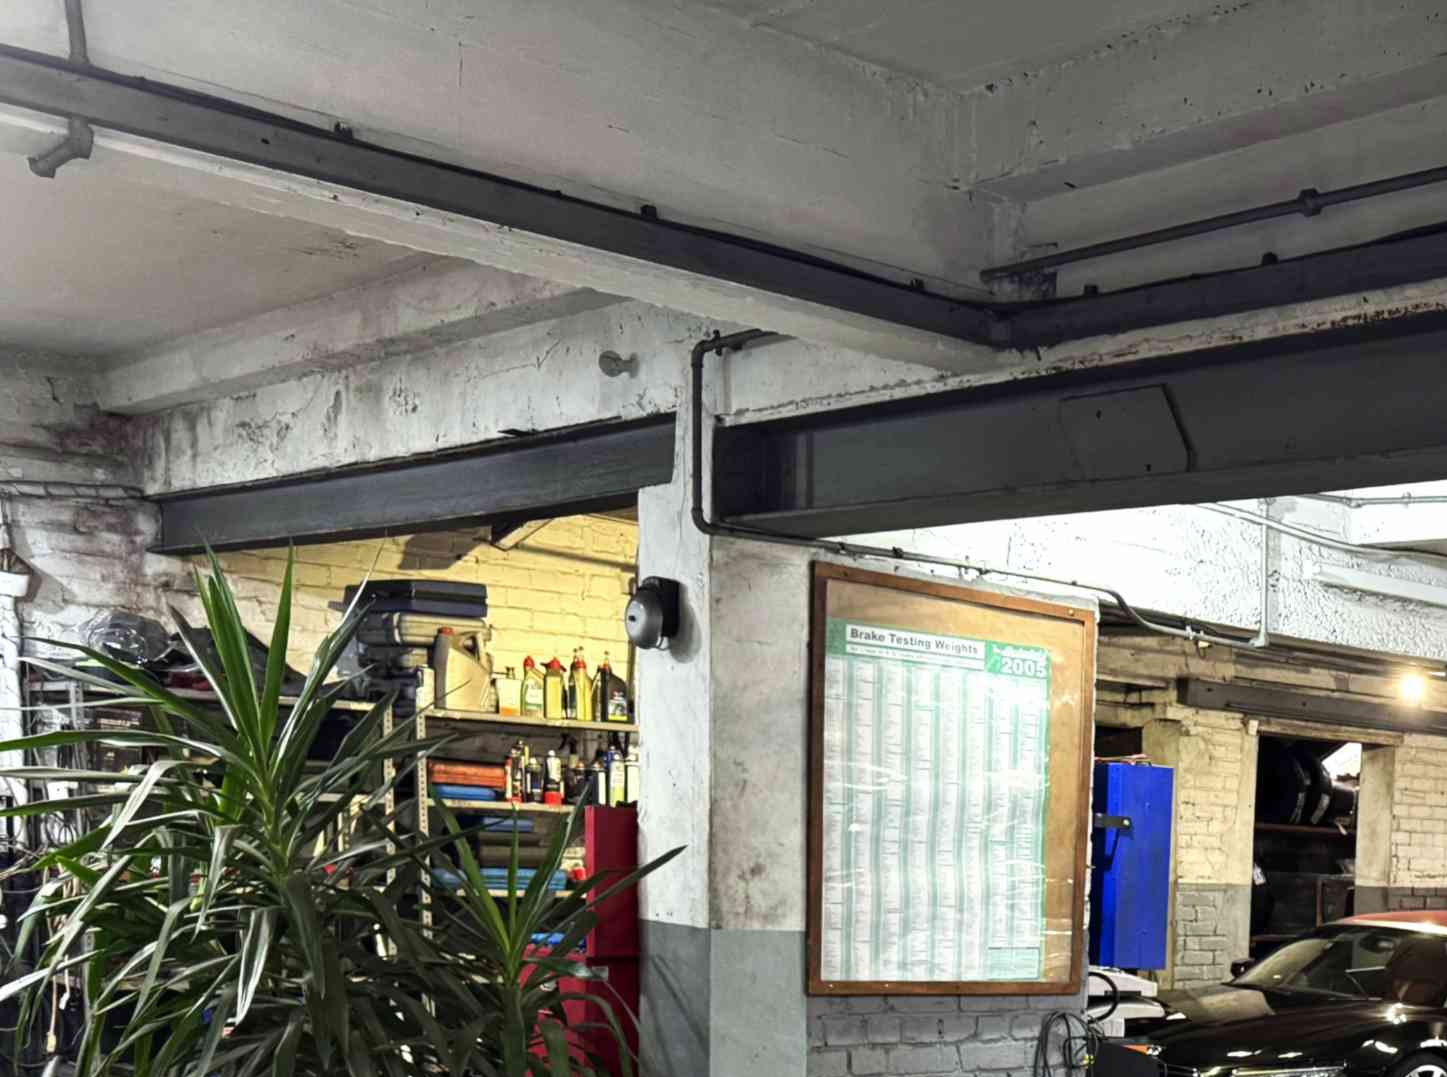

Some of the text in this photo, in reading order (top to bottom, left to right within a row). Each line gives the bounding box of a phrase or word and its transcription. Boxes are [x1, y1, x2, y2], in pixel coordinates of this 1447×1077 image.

[850, 628, 885, 642] Brake
[889, 633, 931, 649] Testing
[935, 639, 978, 654] Weights
[1001, 656, 1046, 678] 2005
